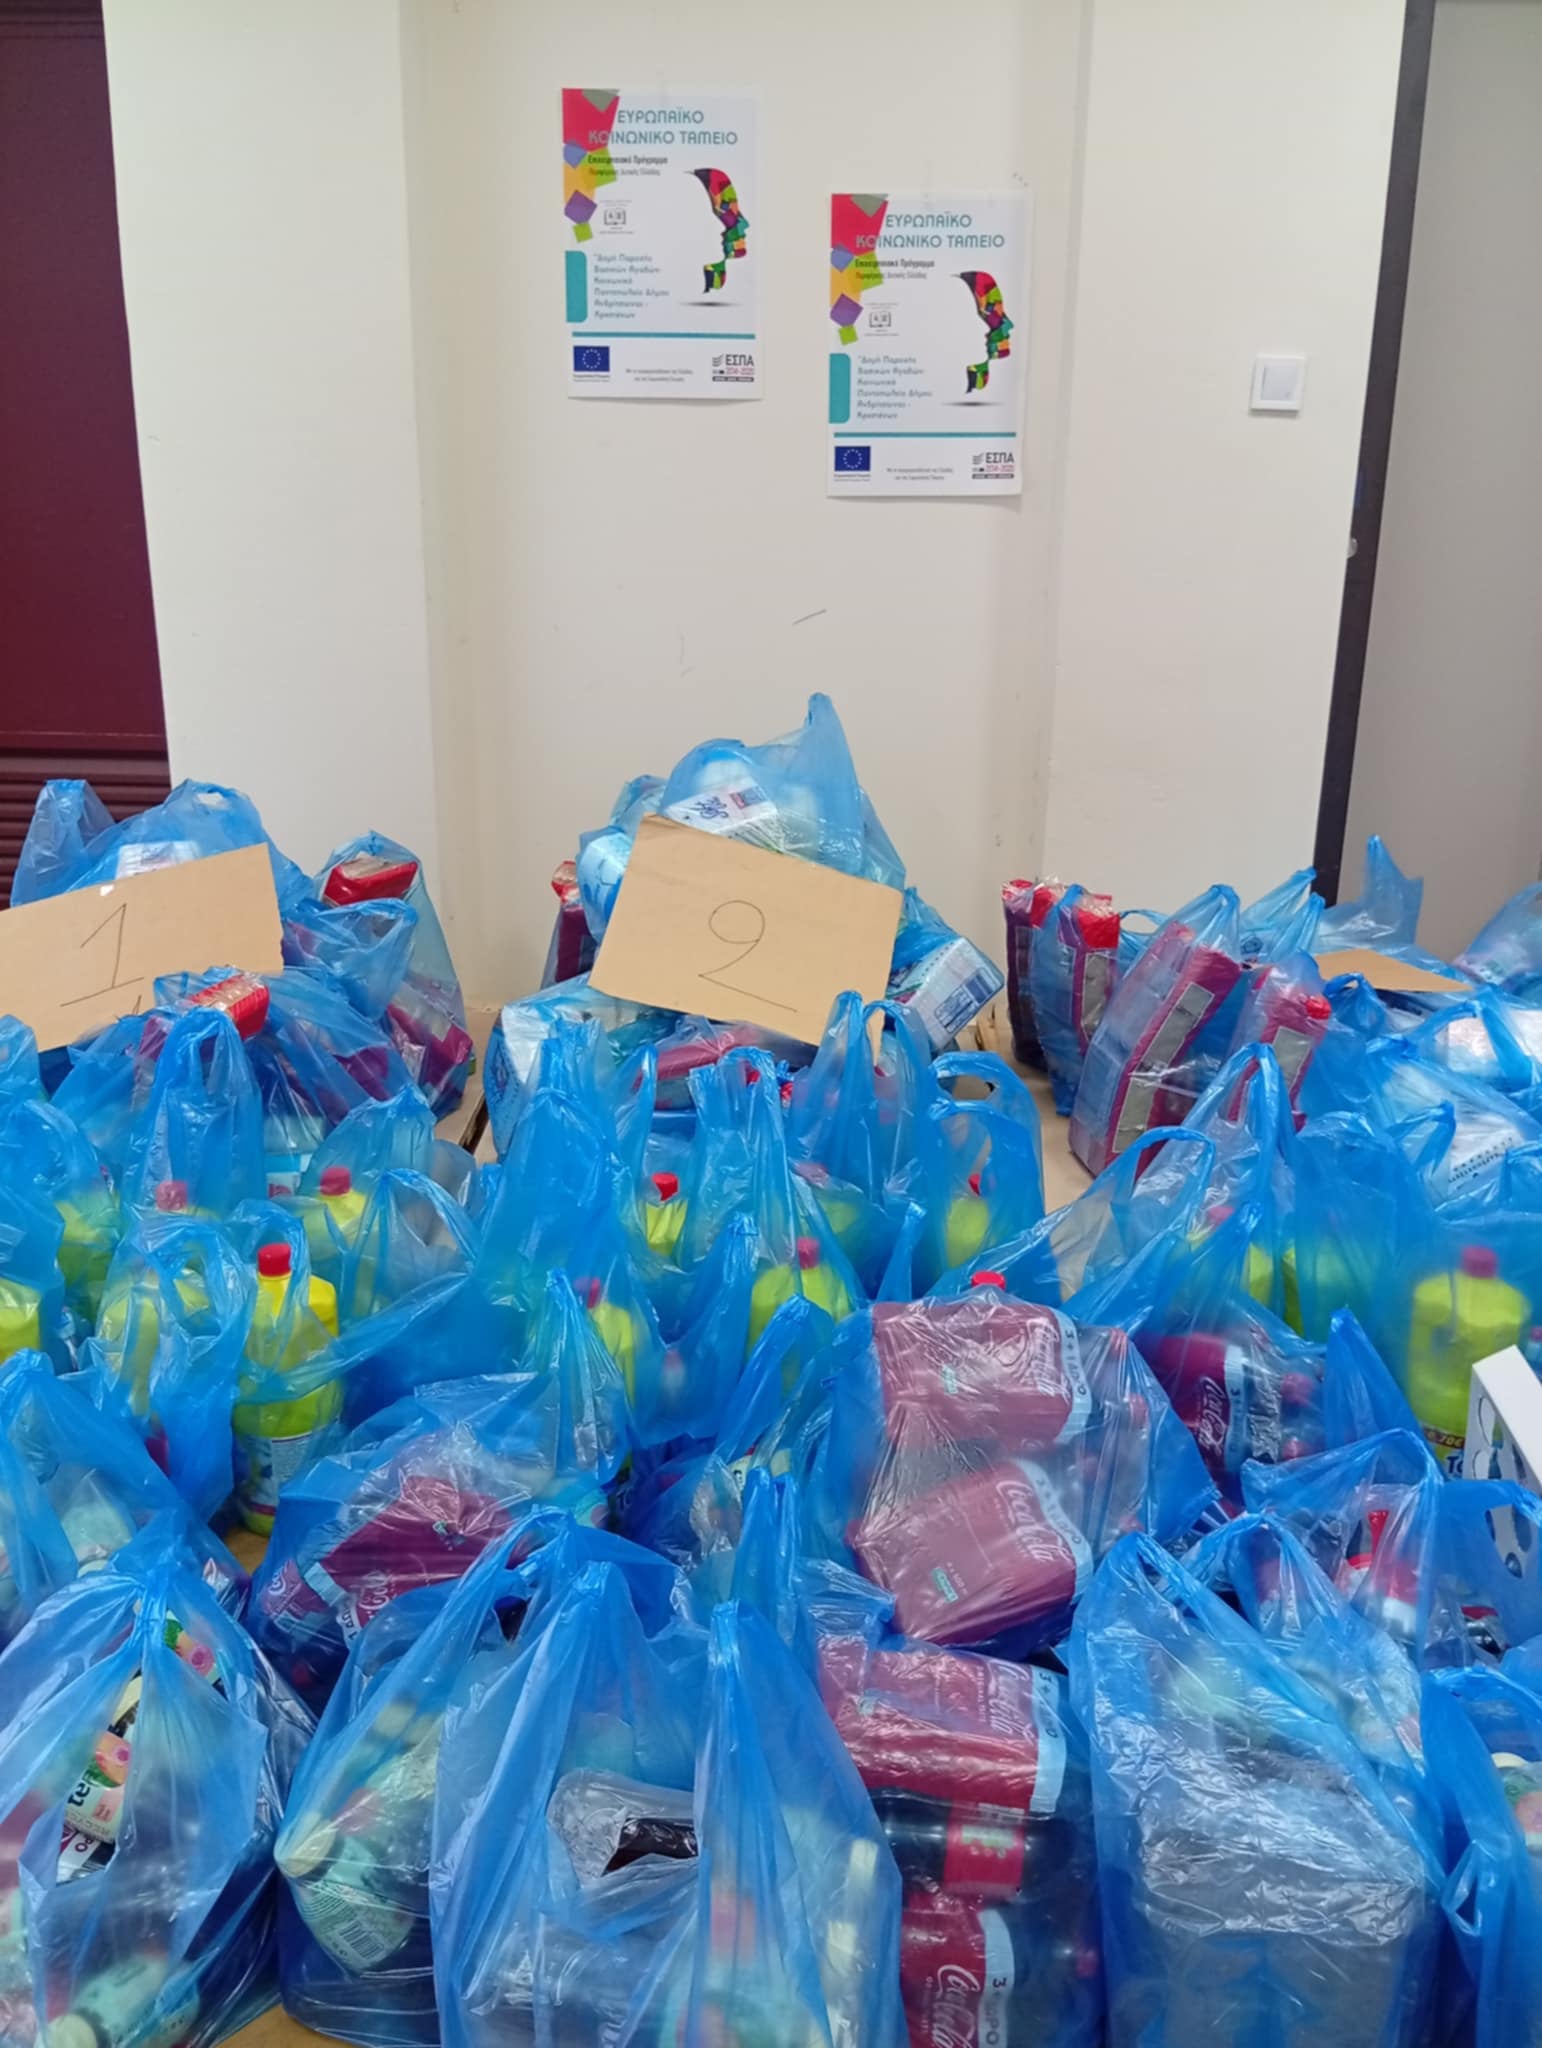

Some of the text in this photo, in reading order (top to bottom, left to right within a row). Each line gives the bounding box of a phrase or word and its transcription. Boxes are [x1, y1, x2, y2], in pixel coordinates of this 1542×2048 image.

[618, 107, 704, 124] ΕΥΡΩΠΑΪΚΟ
[588, 131, 738, 145] ΚΟΙΝΩΝΙΚΟ ΤΑΜΕΙΟ
[886, 211, 972, 228] ΕΥΡΩΠΑΪΚΟ
[856, 235, 1005, 248] ΚΟΙΝΩΝΙΚΟ ΤΑΜΕΙΟ
[726, 354, 754, 366] ΕΣΠΑ
[986, 452, 1014, 463] ΕΣΠΑ
[60, 902, 145, 1007] 1
